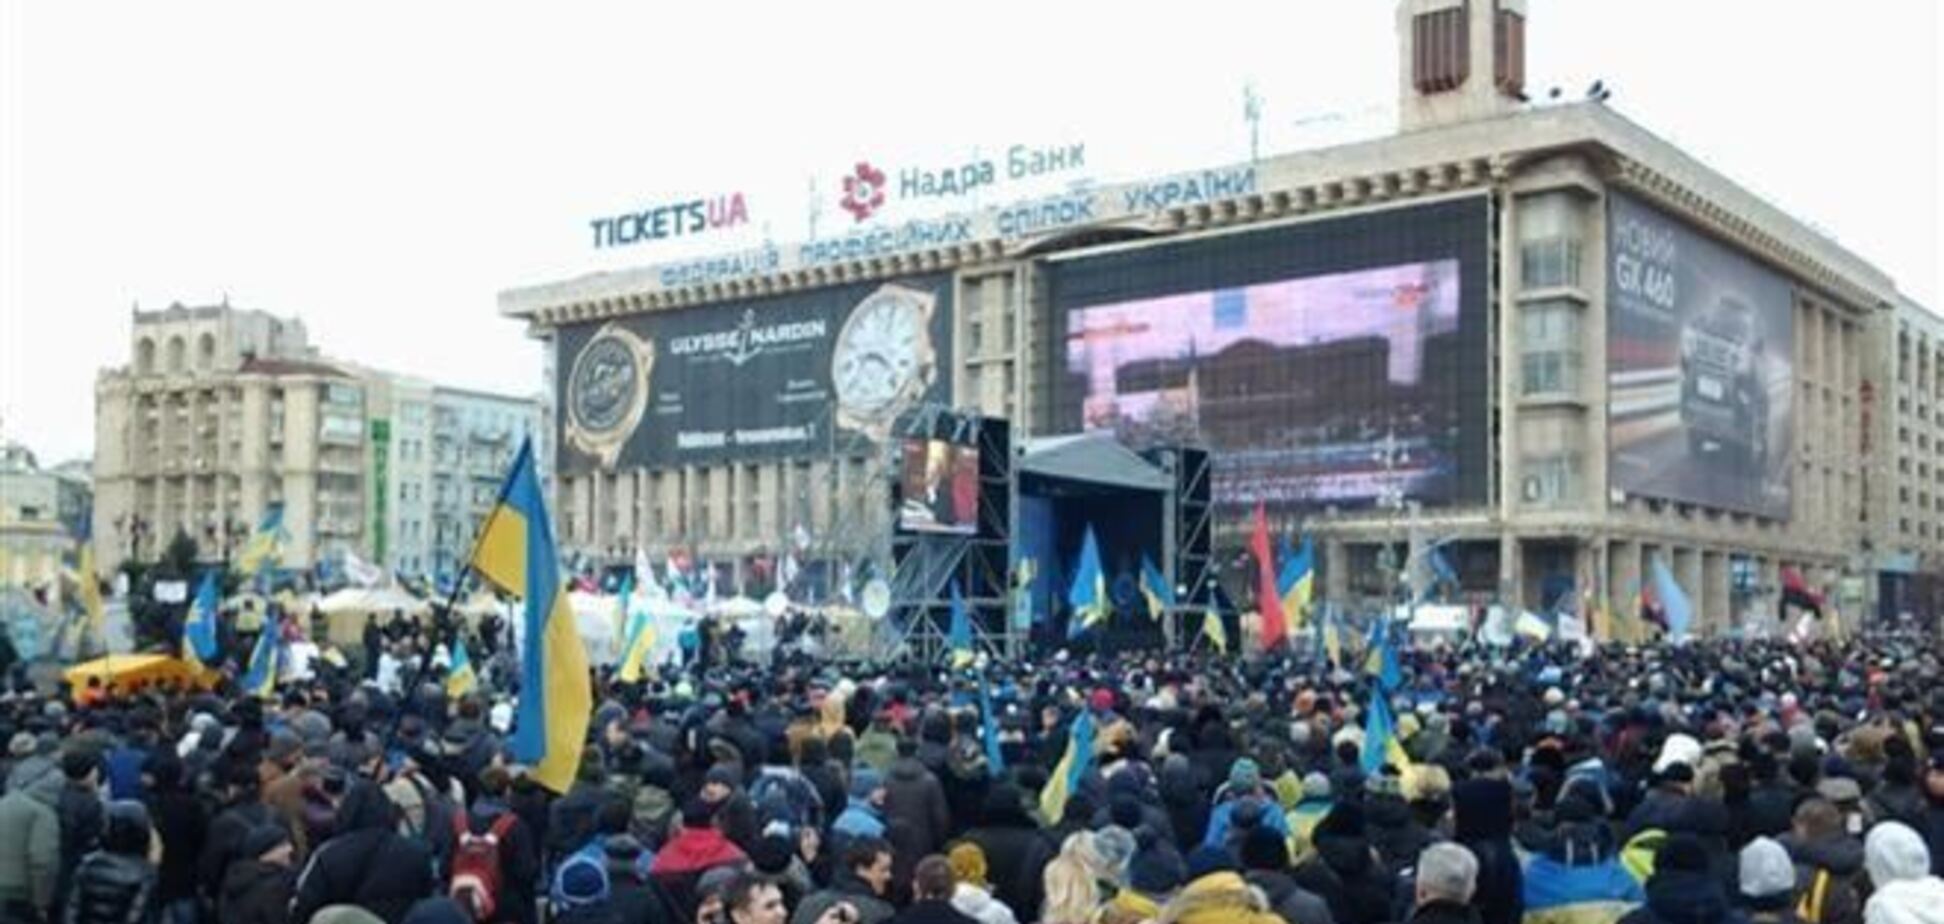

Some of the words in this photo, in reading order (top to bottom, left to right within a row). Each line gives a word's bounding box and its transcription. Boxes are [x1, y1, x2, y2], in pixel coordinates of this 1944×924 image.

[900, 160, 995, 200] Надра
[1008, 143, 1085, 180] Банк
[1125, 168, 1256, 213] УКРАЇНИ
[1643, 265, 1675, 308] 460
[670, 329, 740, 355] ULYSSE
[750, 319, 826, 346] NARDIN
